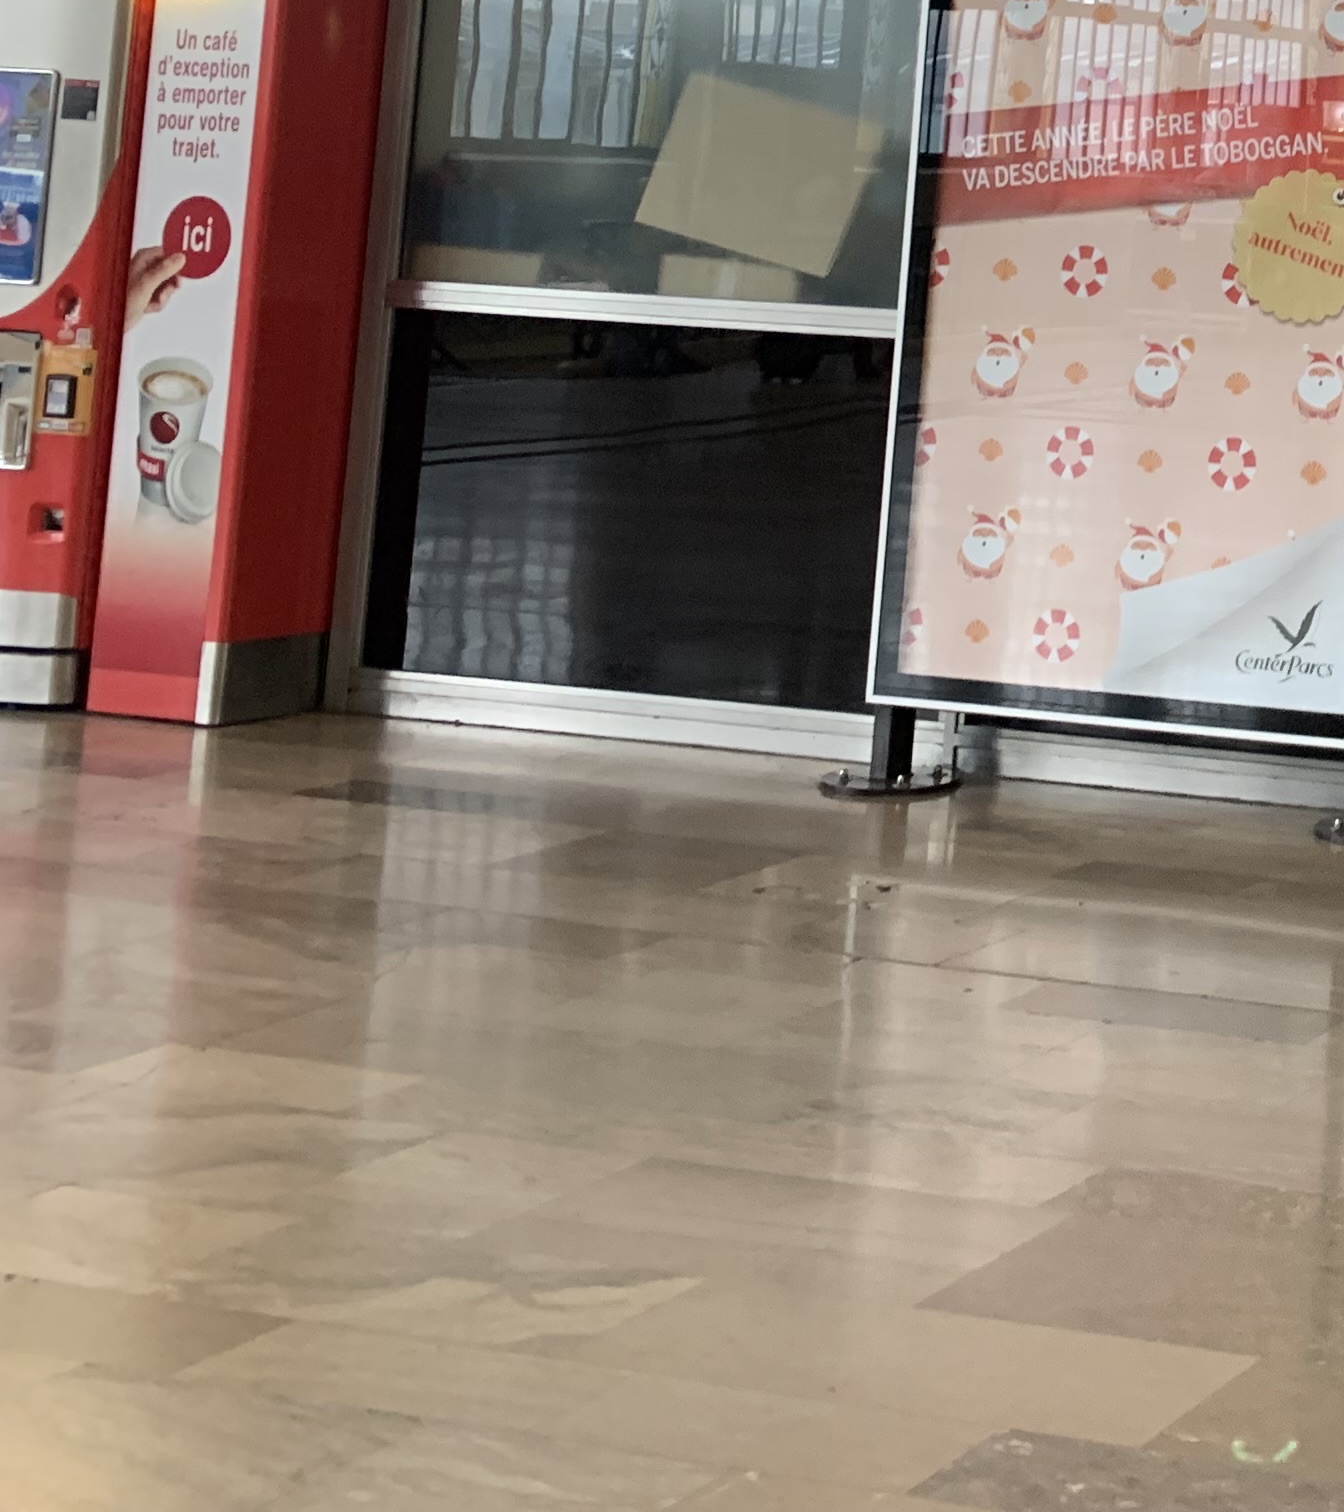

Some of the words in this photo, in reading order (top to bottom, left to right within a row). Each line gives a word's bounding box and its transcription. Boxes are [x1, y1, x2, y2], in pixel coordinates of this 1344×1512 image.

[176, 29, 198, 50] Un
[203, 29, 238, 51] café
[158, 55, 250, 83] d'exception
[157, 84, 166, 102] à
[172, 88, 246, 113] emporter
[157, 114, 193, 133] pour
[200, 113, 240, 133] votre
[962, 131, 1027, 158] CETTE
[1112, 118, 1136, 142] LE
[1142, 108, 1197, 139] PÈRE
[1201, 102, 1259, 133] NOËL
[172, 138, 220, 163] trajet.
[962, 168, 990, 191] VA
[994, 154, 1120, 187] DESCENDRE
[1125, 149, 1165, 173] PAR
[1171, 145, 1197, 169] LE
[1200, 132, 1329, 166] TOBOGGAN.
[182, 215, 213, 252] ici
